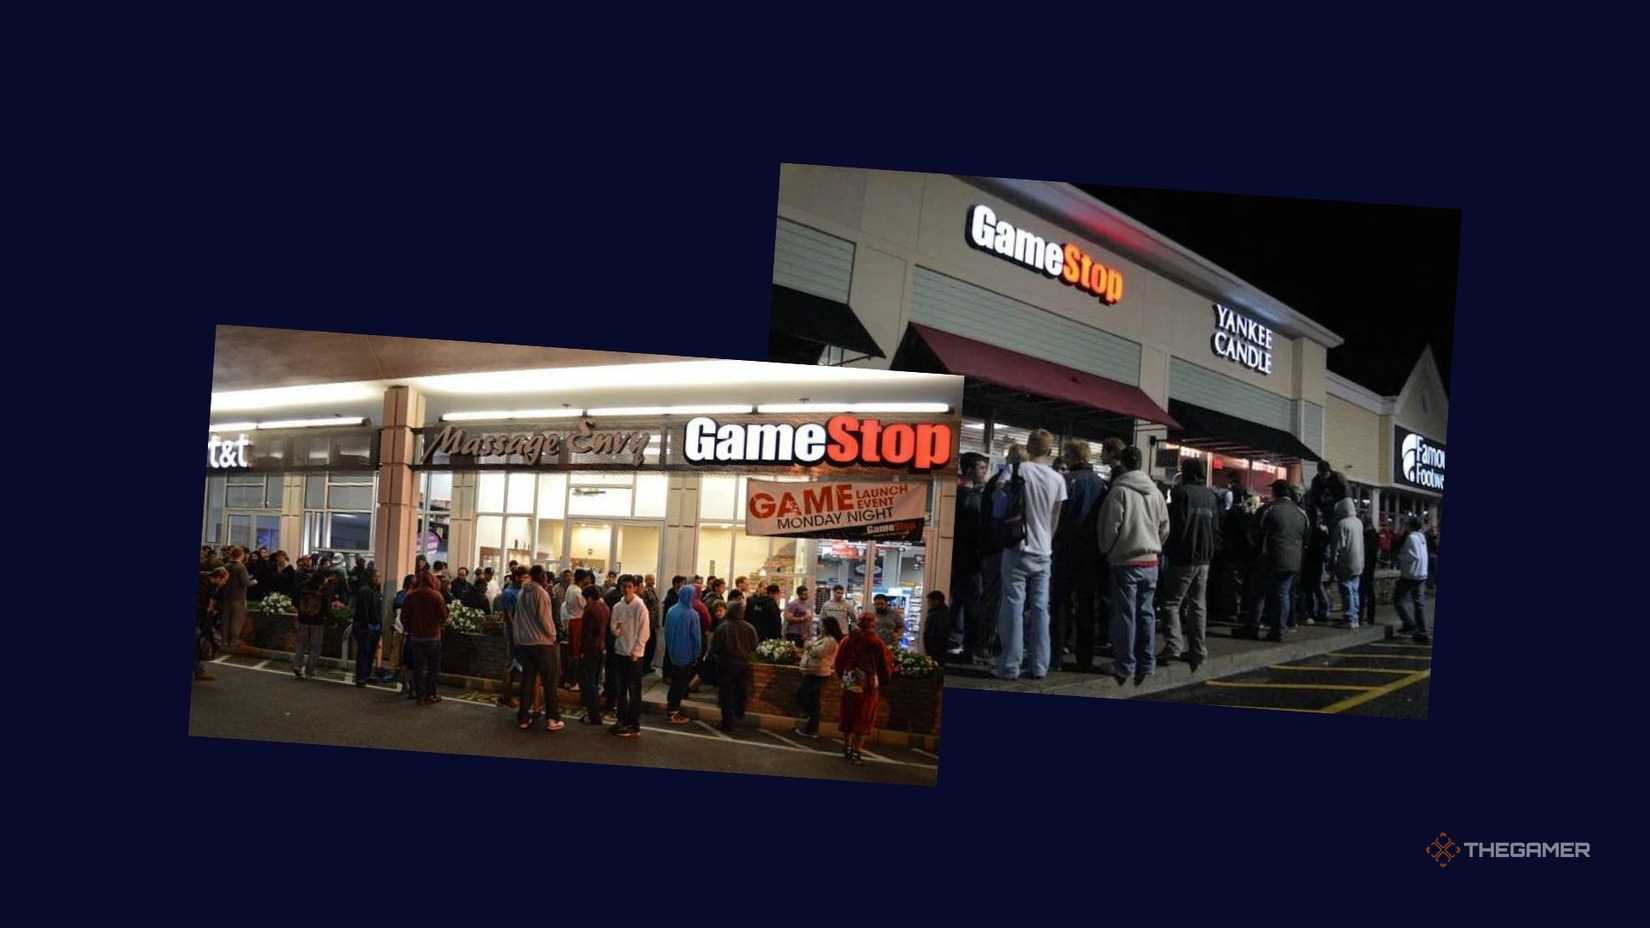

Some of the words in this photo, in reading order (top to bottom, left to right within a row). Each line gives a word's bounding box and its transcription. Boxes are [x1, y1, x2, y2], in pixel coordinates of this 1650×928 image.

[971, 204, 1124, 303] GameStop
[1216, 304, 1273, 350] YANKEE
[1214, 332, 1273, 375] CANDLE
[423, 424, 559, 464] Massage
[565, 418, 652, 467] Envy
[684, 415, 953, 470] GameStop
[749, 484, 854, 519] GAME
[855, 484, 909, 500] LAUNCH
[856, 497, 895, 510] EVENT
[777, 512, 843, 530] MONDAY
[847, 507, 894, 525] NIGHT
